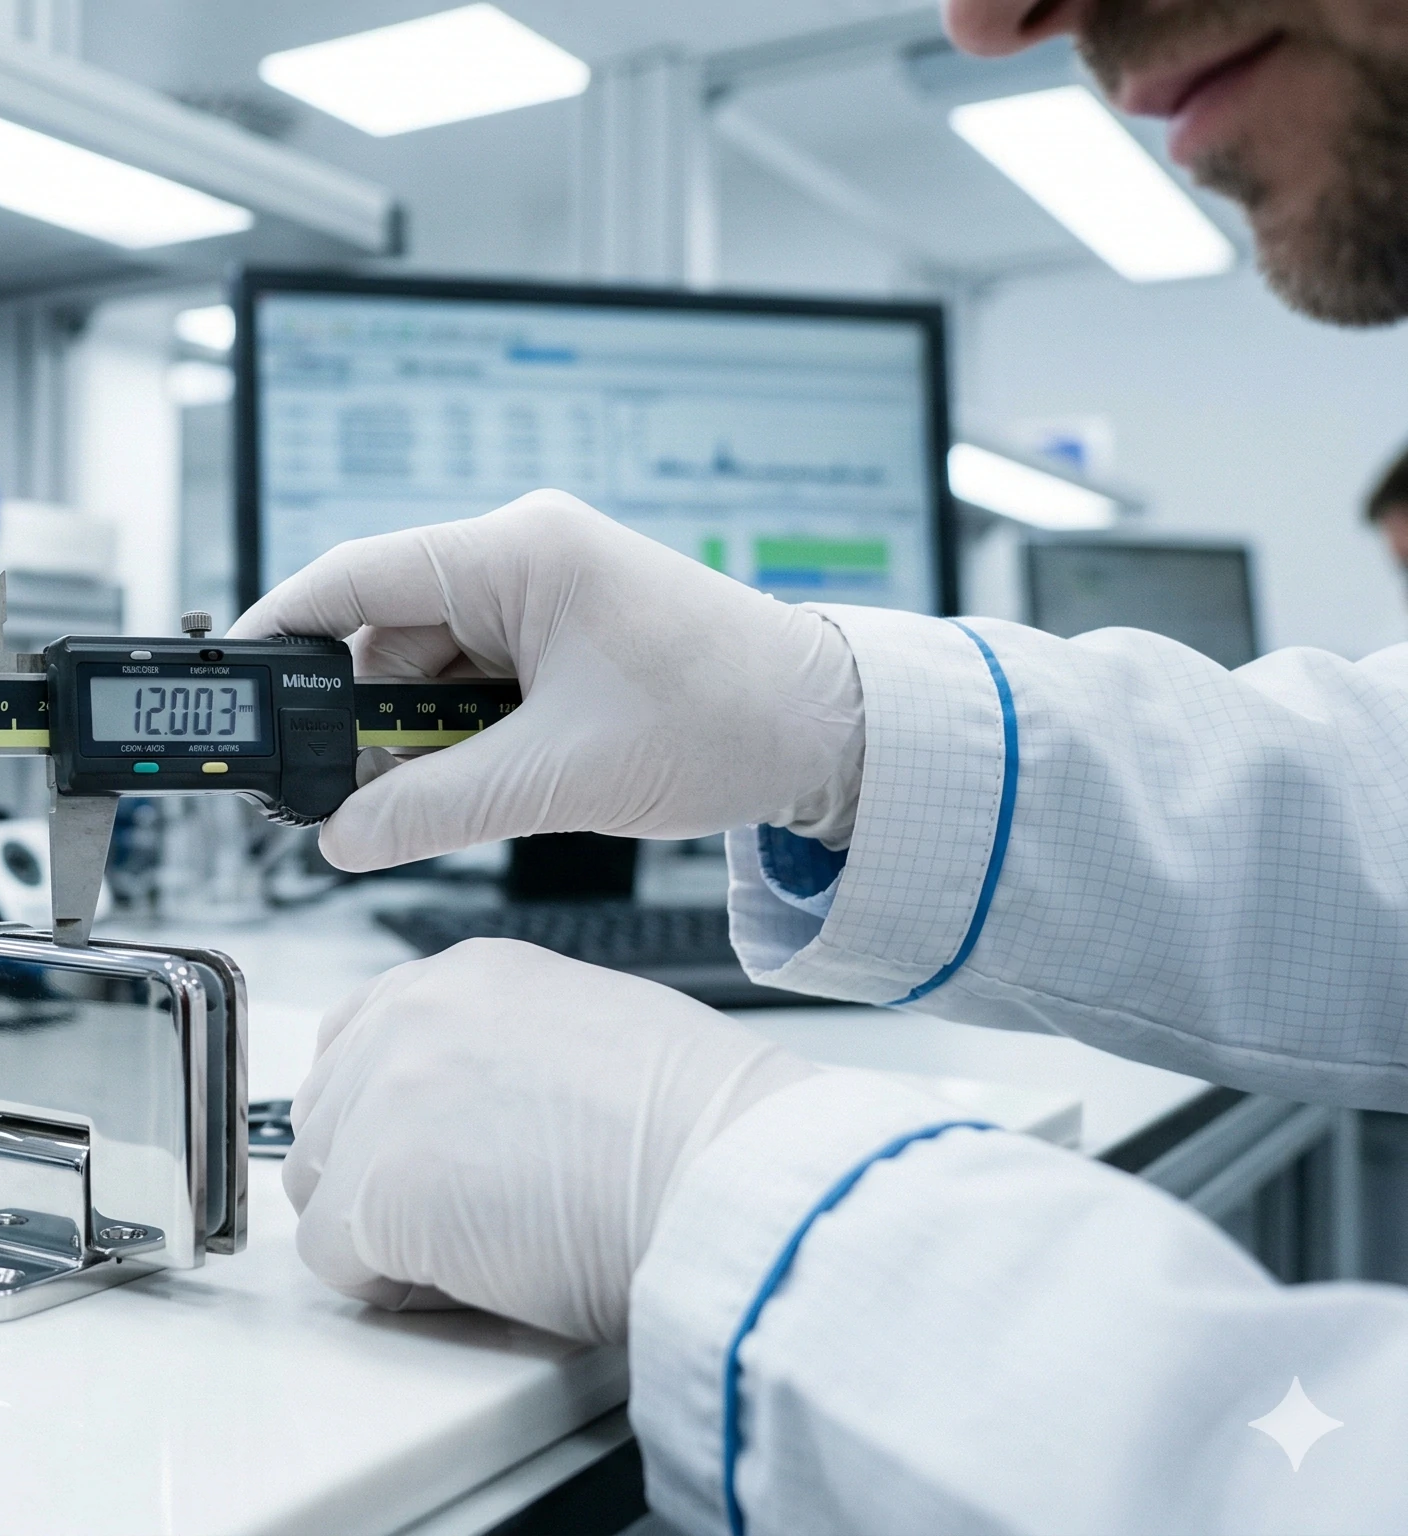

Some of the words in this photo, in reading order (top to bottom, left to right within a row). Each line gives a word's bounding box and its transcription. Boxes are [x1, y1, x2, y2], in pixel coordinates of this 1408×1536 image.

[282, 673, 342, 692] Mitutoyo
[134, 687, 237, 736] 12.003
[238, 704, 254, 713] mm
[378, 702, 394, 713] 90
[416, 702, 436, 714] 100
[457, 703, 478, 714] 110
